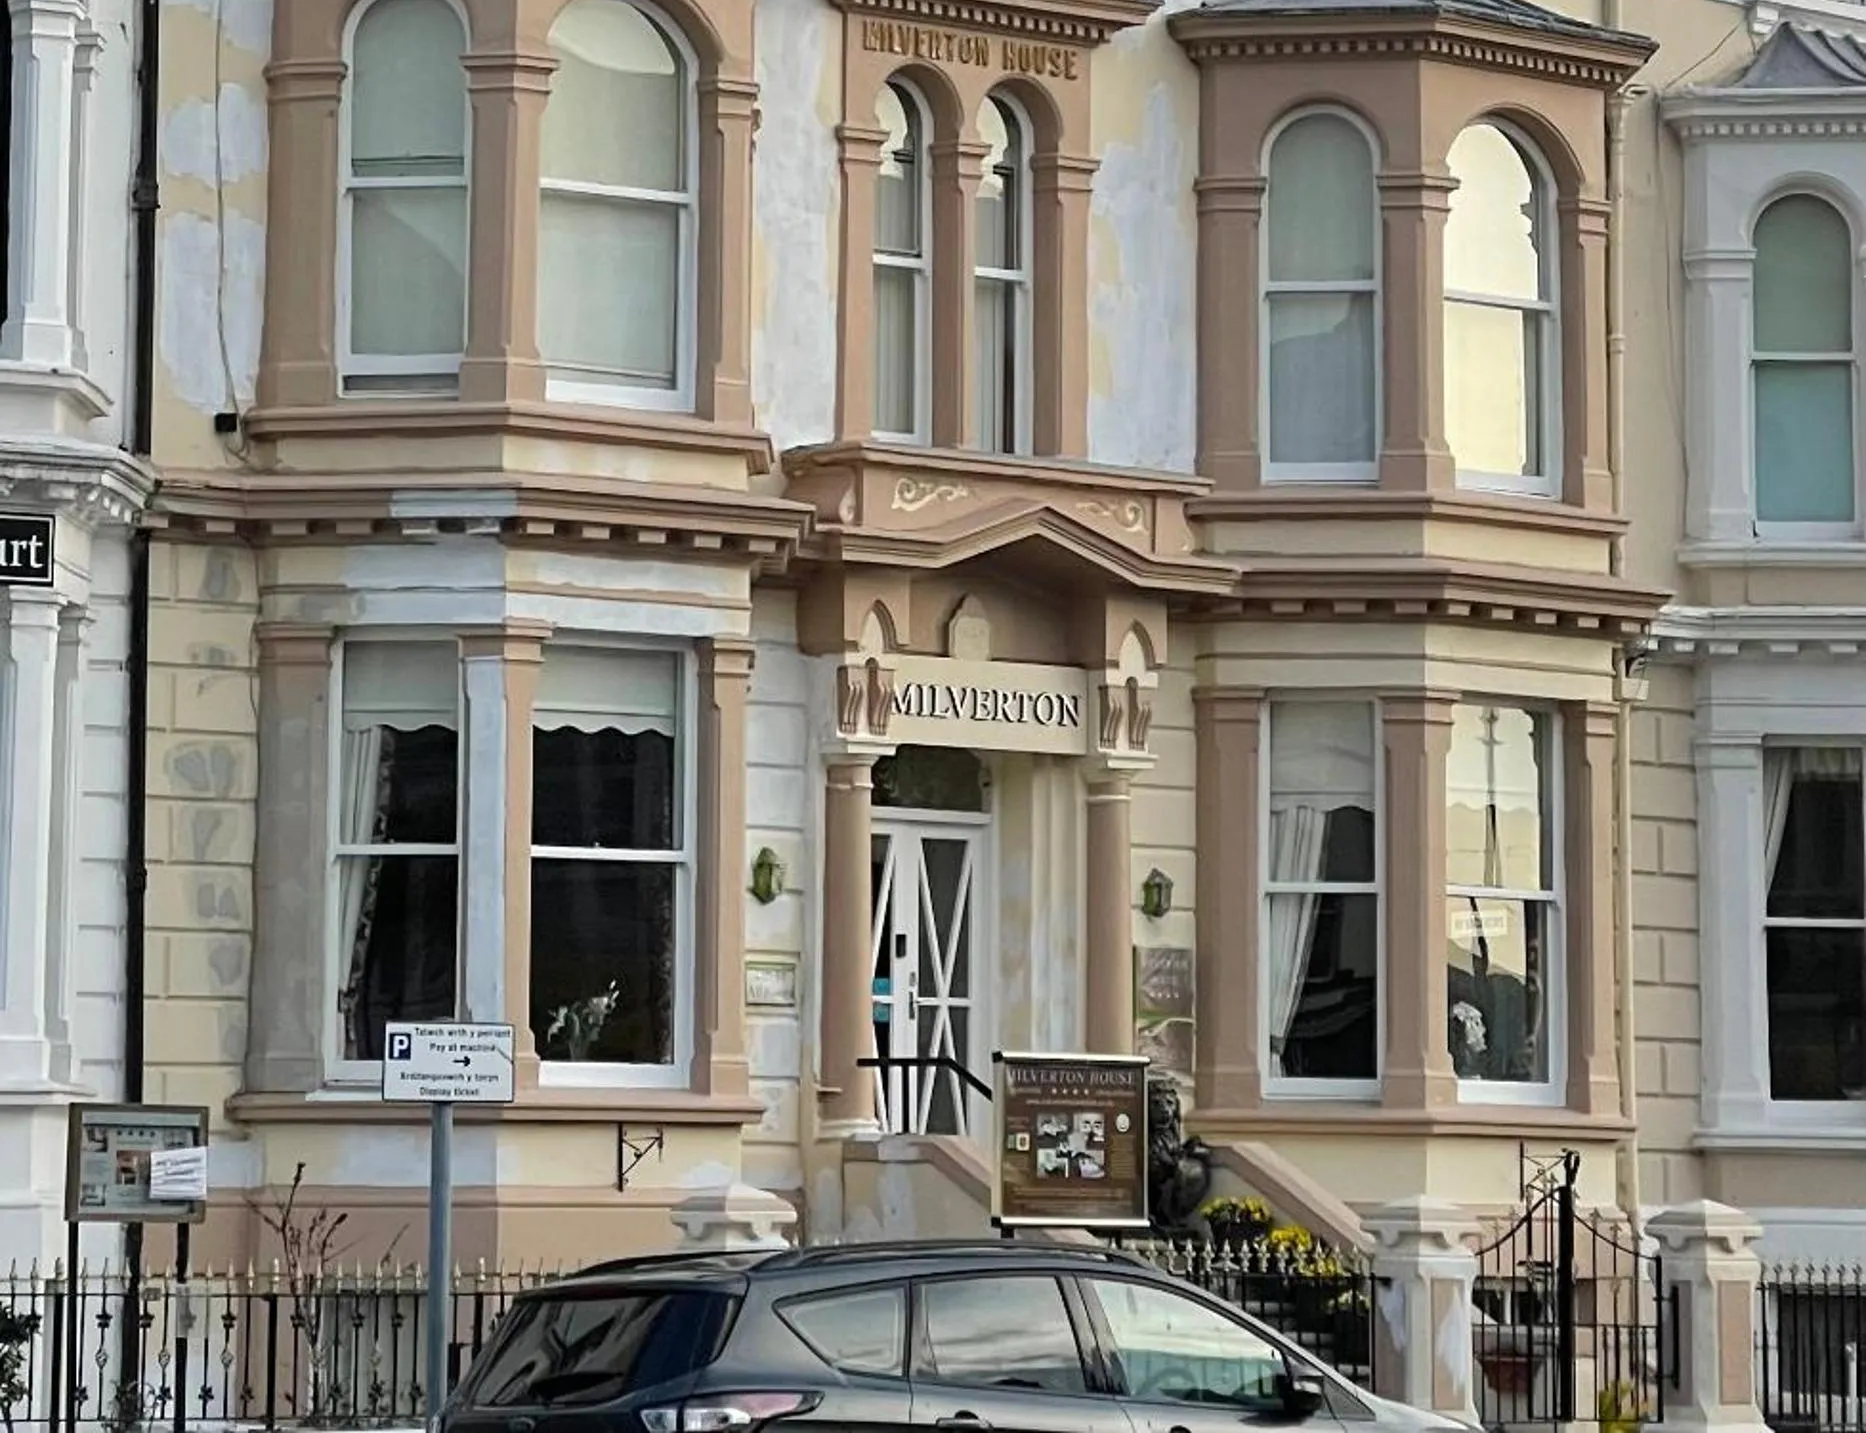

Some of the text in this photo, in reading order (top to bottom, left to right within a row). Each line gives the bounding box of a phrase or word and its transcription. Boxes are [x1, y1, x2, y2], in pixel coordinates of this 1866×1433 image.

[862, 19, 1079, 80] MILVERTON HOUSE
[890, 682, 1081, 728] MILVERTON
[392, 1034, 410, 1058] P
[429, 1043, 446, 1053] Pay
